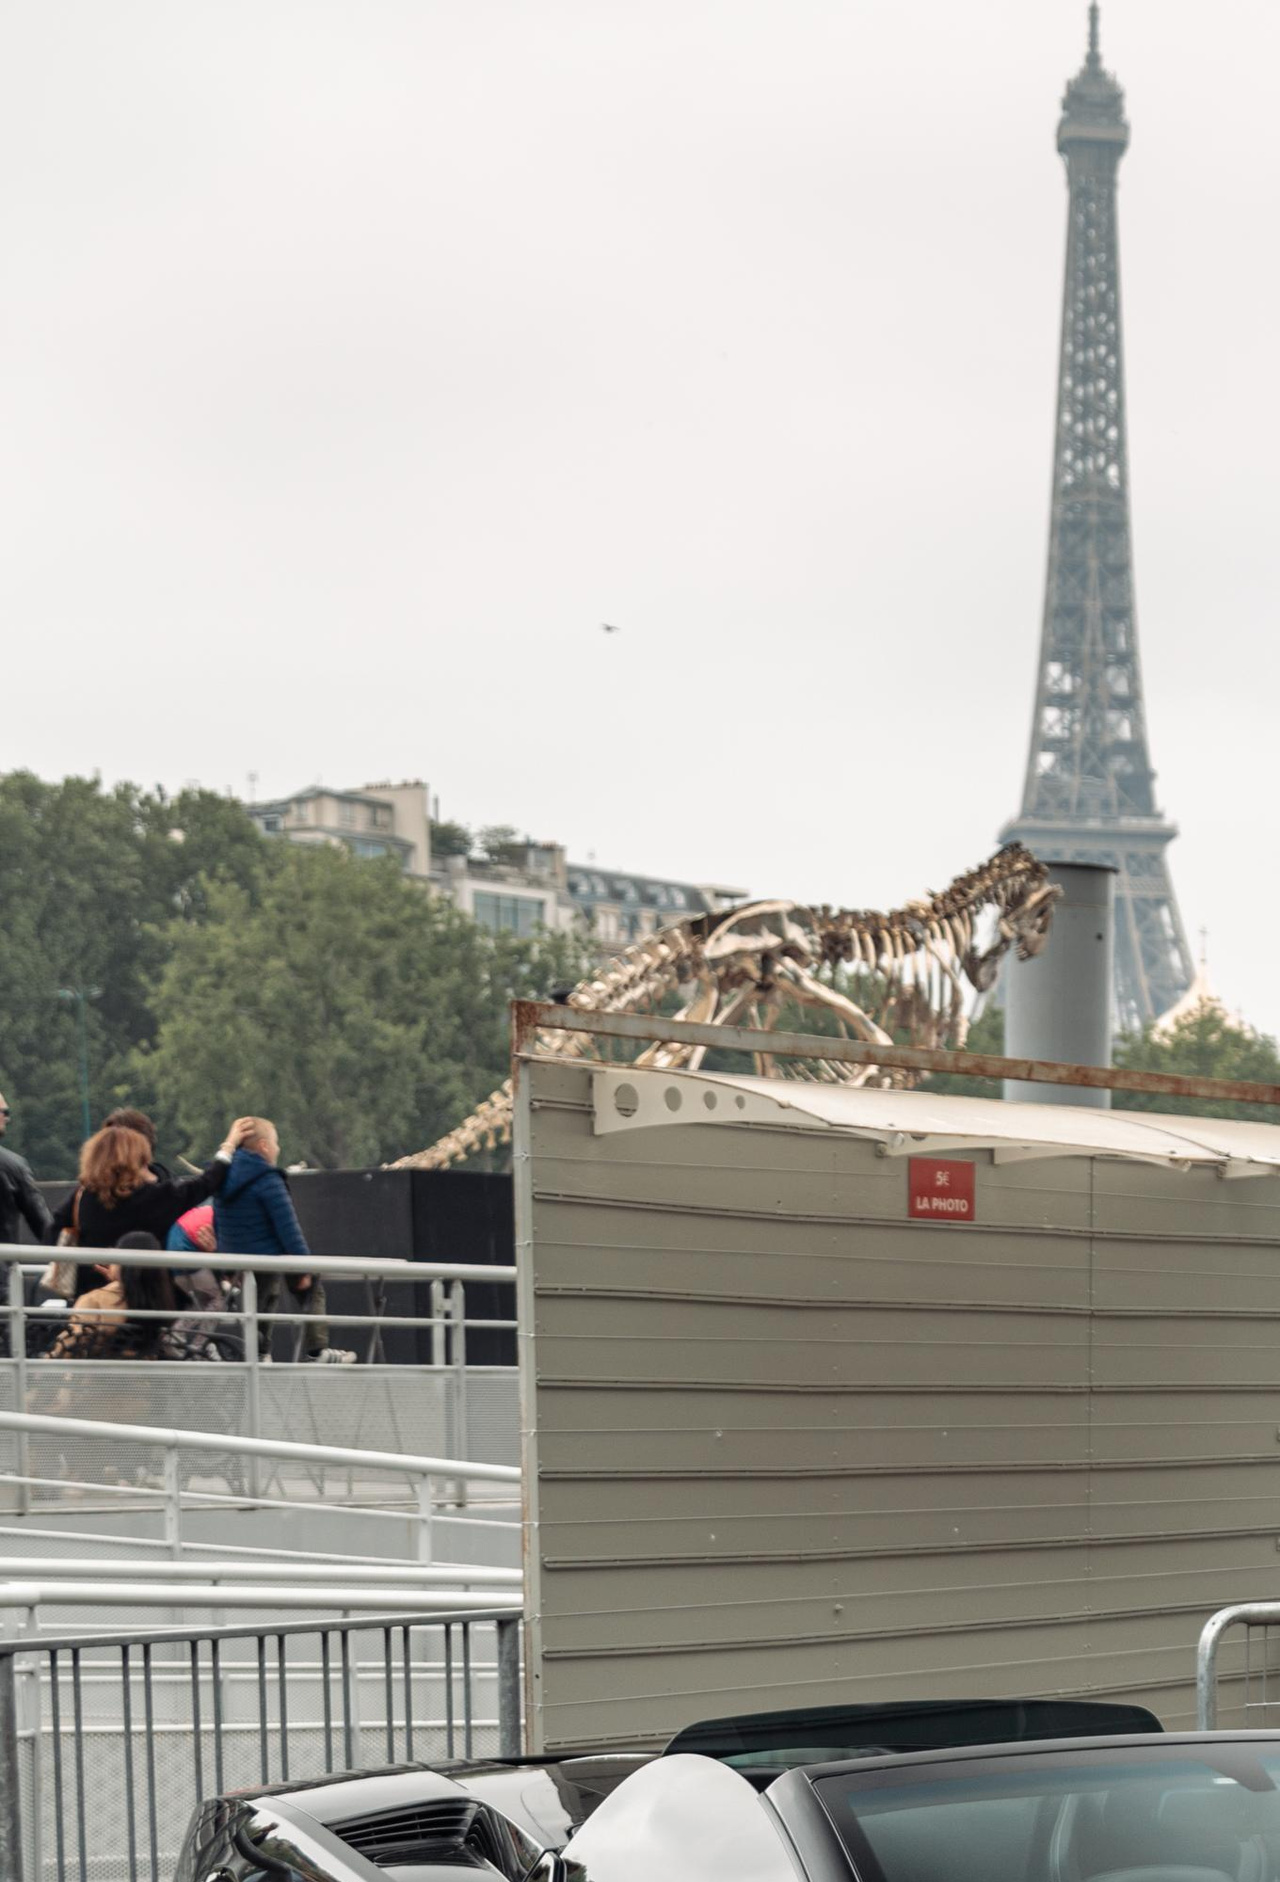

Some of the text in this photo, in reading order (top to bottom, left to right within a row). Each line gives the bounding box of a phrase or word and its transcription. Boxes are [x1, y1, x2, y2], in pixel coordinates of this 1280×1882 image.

[935, 1171, 950, 1186] 5€
[916, 1196, 968, 1213] LA PHOTO
